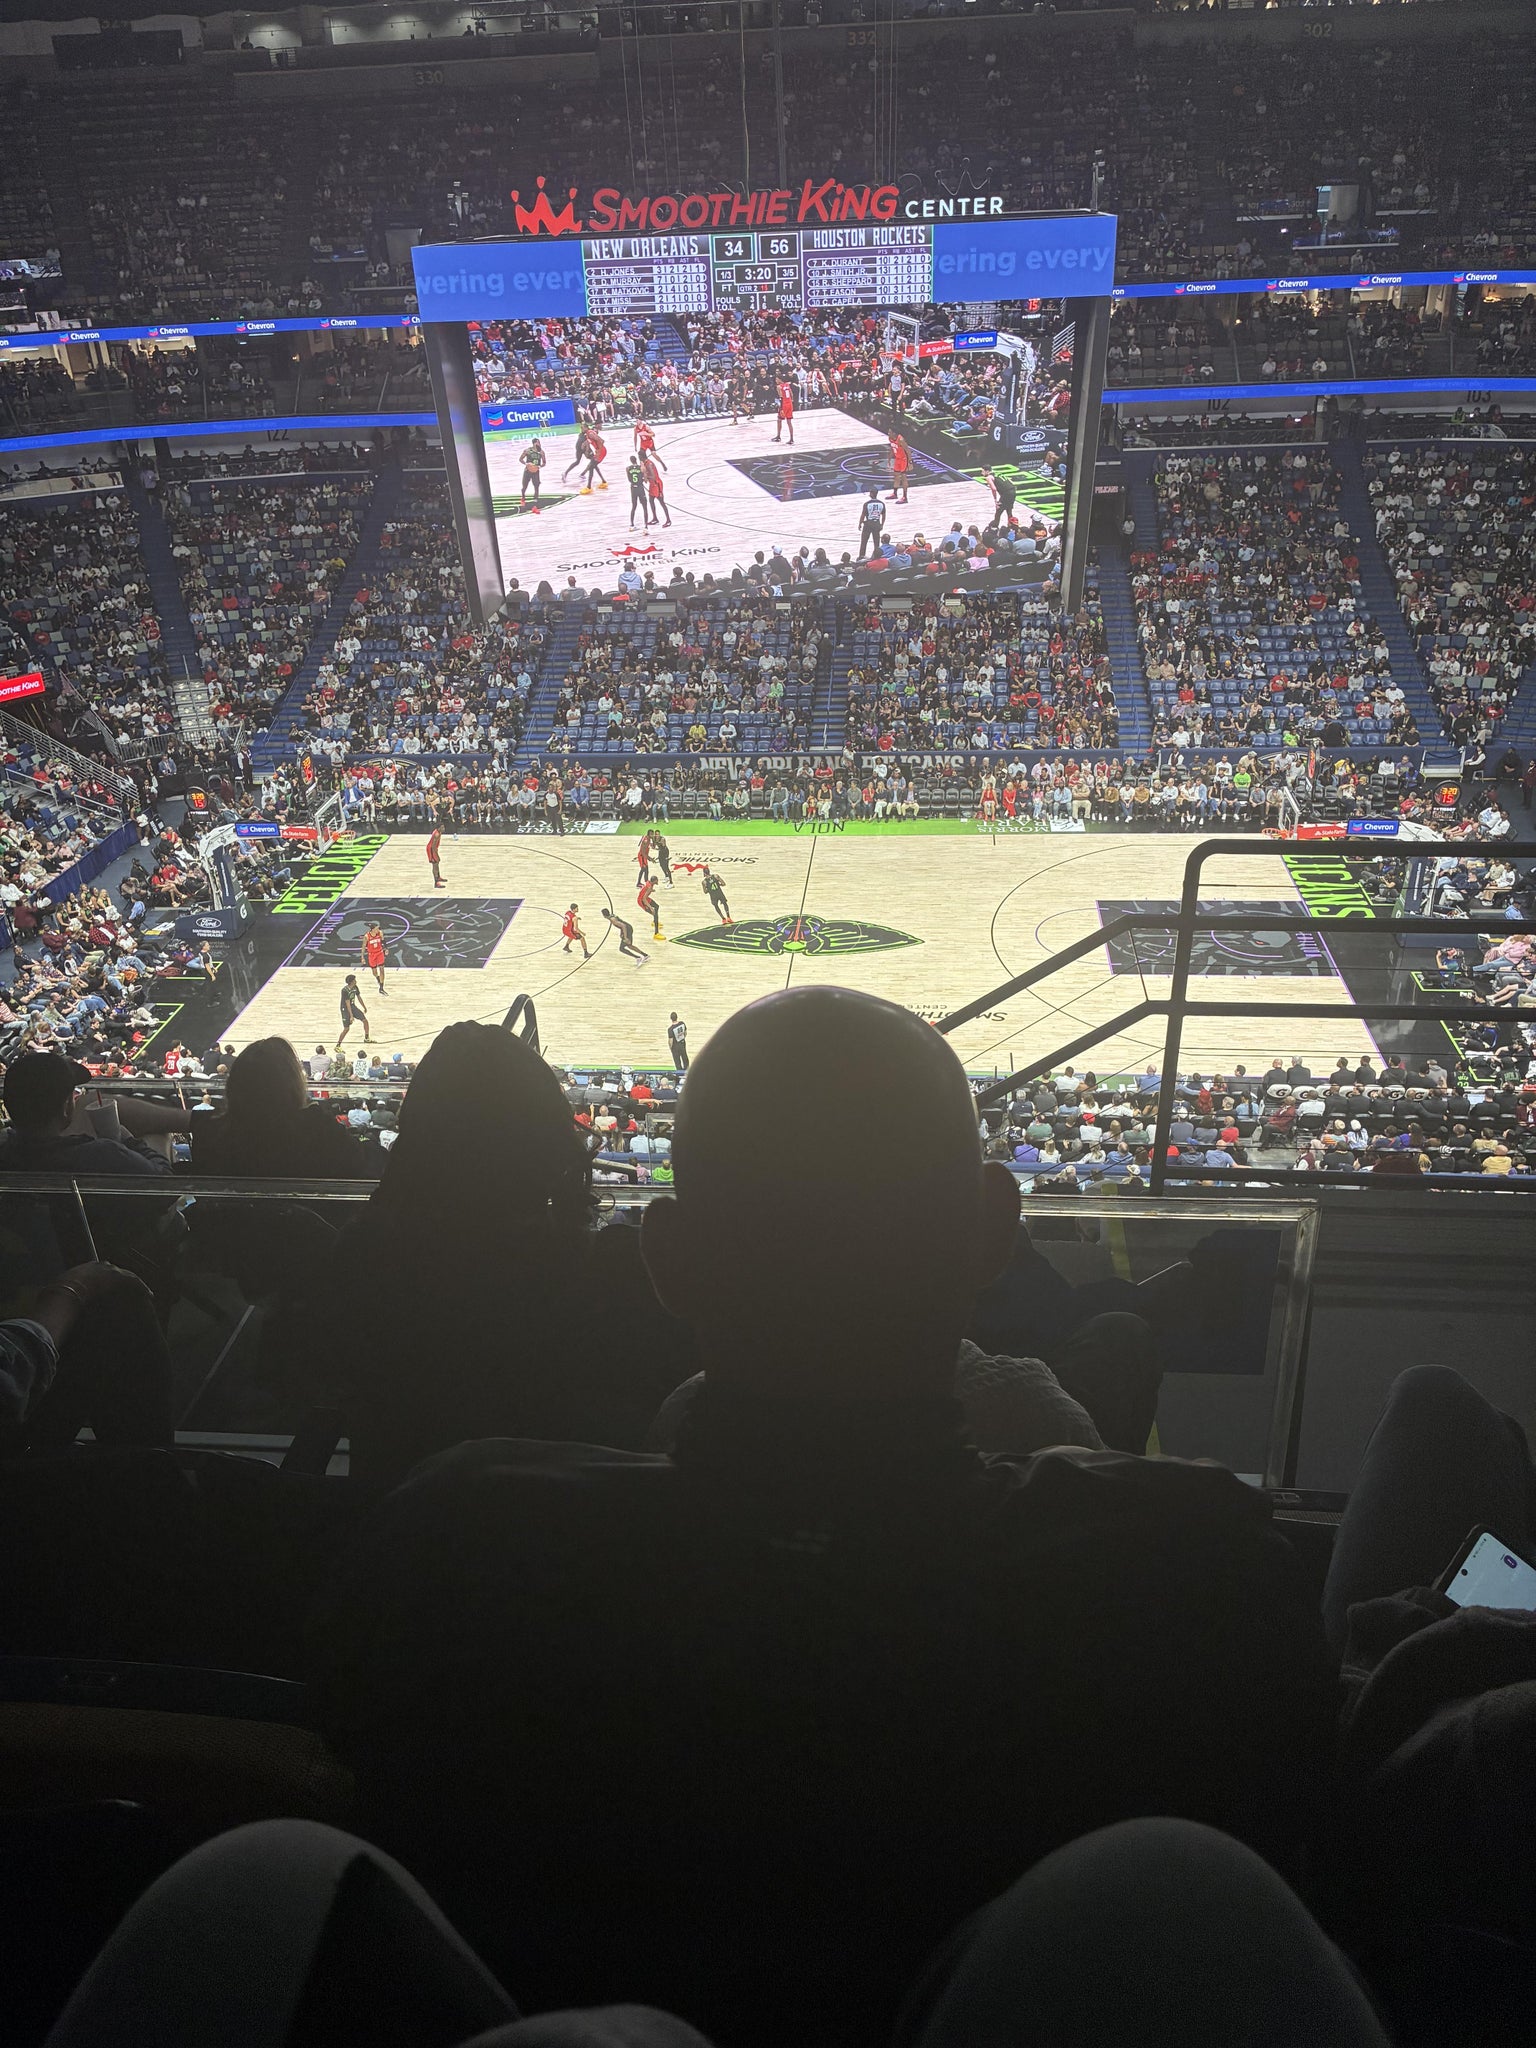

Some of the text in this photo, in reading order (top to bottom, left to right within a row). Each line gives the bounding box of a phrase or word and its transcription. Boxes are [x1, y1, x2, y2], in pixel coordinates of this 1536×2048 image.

[1304, 22, 1333, 38] 302
[847, 31, 876, 47] 332
[415, 70, 443, 85] 330
[589, 188, 791, 231] SMOOTHIE
[905, 196, 1003, 219] CENTER
[814, 226, 925, 248] HOUSTON ROCKETS
[591, 236, 699, 259] NEW ORLEANS
[724, 241, 743, 256] 34
[770, 239, 789, 254] 56
[1026, 247, 1111, 272] every
[720, 271, 732, 279] 1/3
[745, 268, 771, 280] 3:20
[782, 269, 794, 277] 3/5
[1466, 273, 1497, 281] Chevron
[611, 277, 641, 285] MURRAY
[1279, 280, 1308, 288] Chevron
[1371, 276, 1402, 284] Chevron
[611, 287, 649, 295] MATKOVIC
[1187, 284, 1216, 292] Chevron
[71, 332, 100, 341] Chevron
[160, 327, 188, 335] Chevron
[968, 336, 993, 344] Chevron
[1467, 390, 1491, 403] 103
[1207, 399, 1231, 411] 102
[507, 410, 554, 422] Chevron
[267, 429, 289, 442] 122
[633, 474, 638, 482] 5
[556, 553, 663, 572] SMOOTHIE
[193, 800, 204, 808] 15
[1443, 795, 1454, 803] 15
[793, 821, 845, 834] NOLA
[1364, 823, 1394, 831] Chevron
[272, 834, 390, 914] PELICANS
[200, 918, 217, 927] Ford
